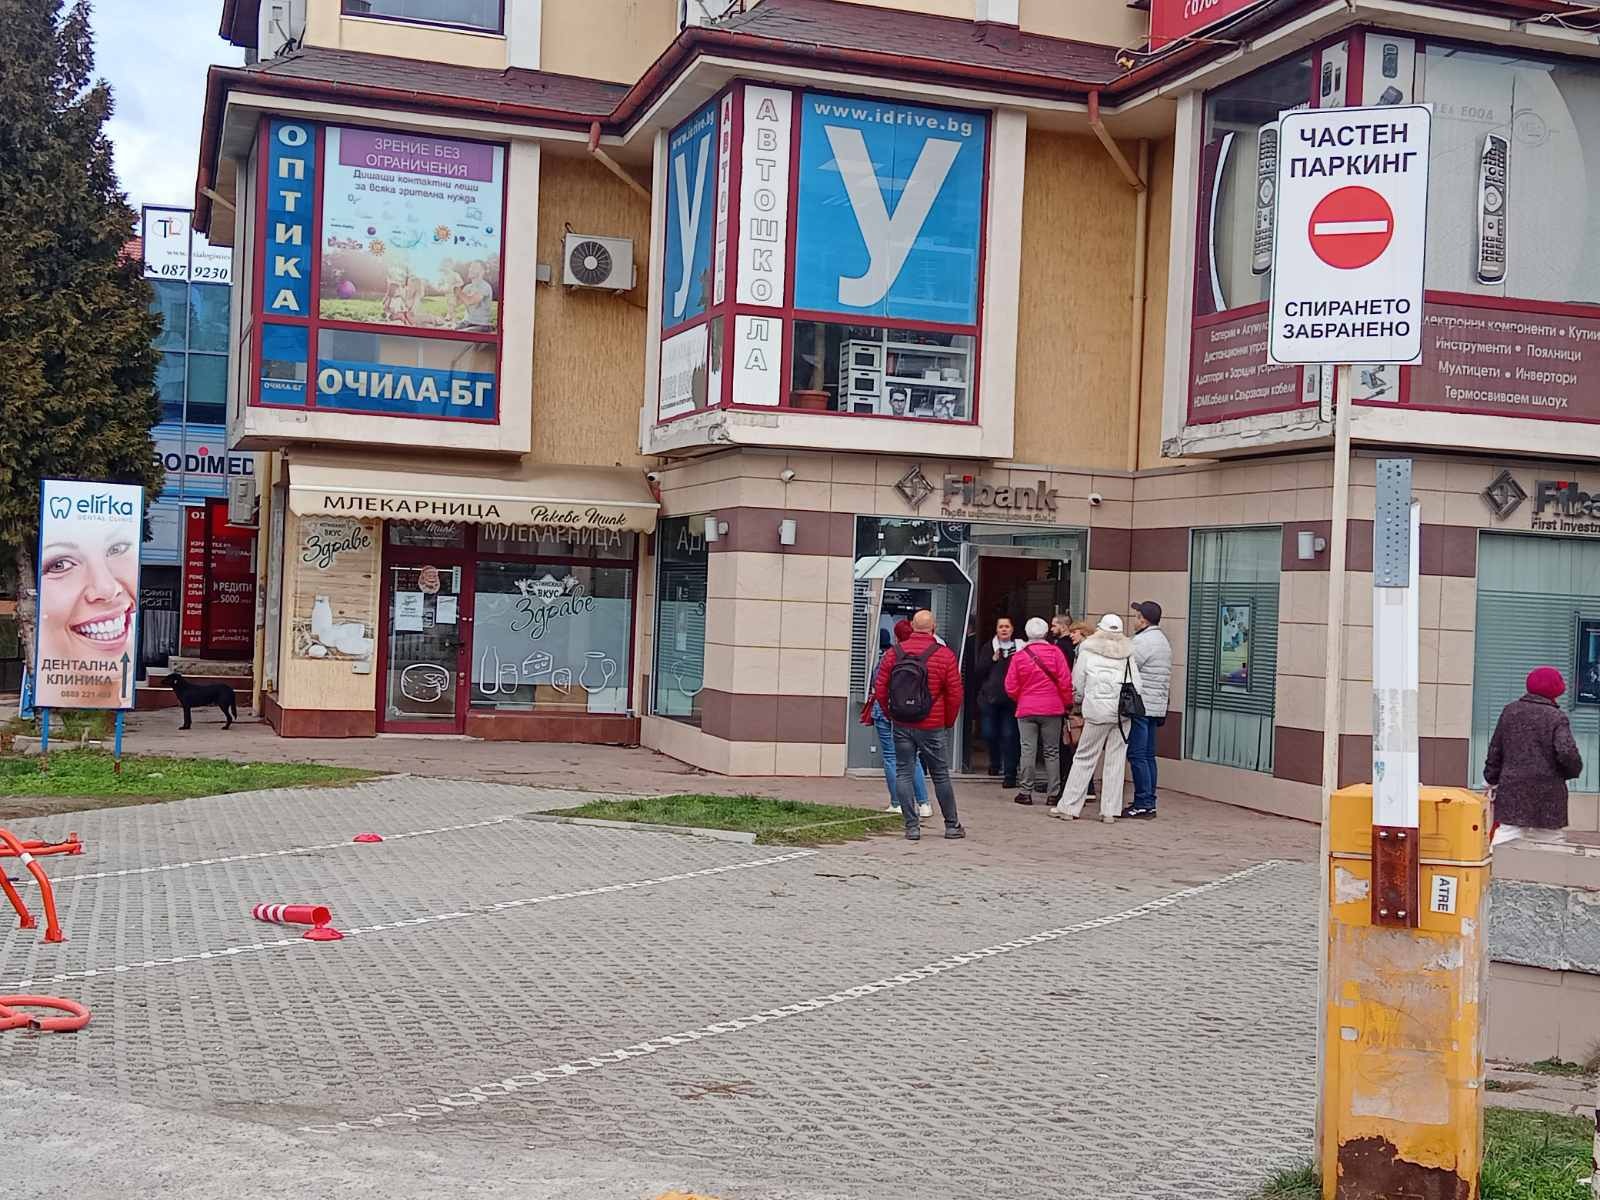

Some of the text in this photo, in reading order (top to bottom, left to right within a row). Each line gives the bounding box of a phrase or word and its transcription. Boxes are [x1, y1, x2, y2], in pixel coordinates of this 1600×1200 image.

[814, 103, 973, 137] www.idrive.bg
[1300, 123, 1408, 148] ЧАСТЕН
[375, 138, 461, 160] ЗРЕНИЕ БЕЗ
[366, 154, 468, 177] ОГРАНИЧЕНИЯ
[1290, 151, 1417, 178] ПАРКИНГ
[353, 169, 479, 193] Дишащи контактни лещи
[355, 182, 477, 205] за всяка зрителна нужда
[272, 125, 307, 311] ОПТИКА
[744, 98, 778, 370] АВТОШКОЛА
[194, 267, 228, 279] 9230
[1285, 298, 1410, 317] СПИРАНЕТО
[1283, 321, 1410, 340] ЗАБРАНЕНО
[1424, 314, 1485, 329] лектронни
[1488, 320, 1556, 337] компоненти
[1435, 335, 1582, 362] Инструменти Поялници
[1438, 360, 1577, 386] Мултицети Инвертори
[318, 368, 492, 407] ОЧИЛА-БГ
[1445, 385, 1568, 409] Термосвиваем шлаух
[942, 473, 1058, 512] Fibank
[323, 496, 500, 518] МЛЕКАРНИЦА
[303, 526, 371, 568] Здраве
[484, 523, 621, 550] МЛЕКАРНИЦА
[511, 584, 595, 640] Здраве
[41, 659, 118, 672] ДЕНТАЛНА
[46, 674, 112, 685] КЛИНИКА
